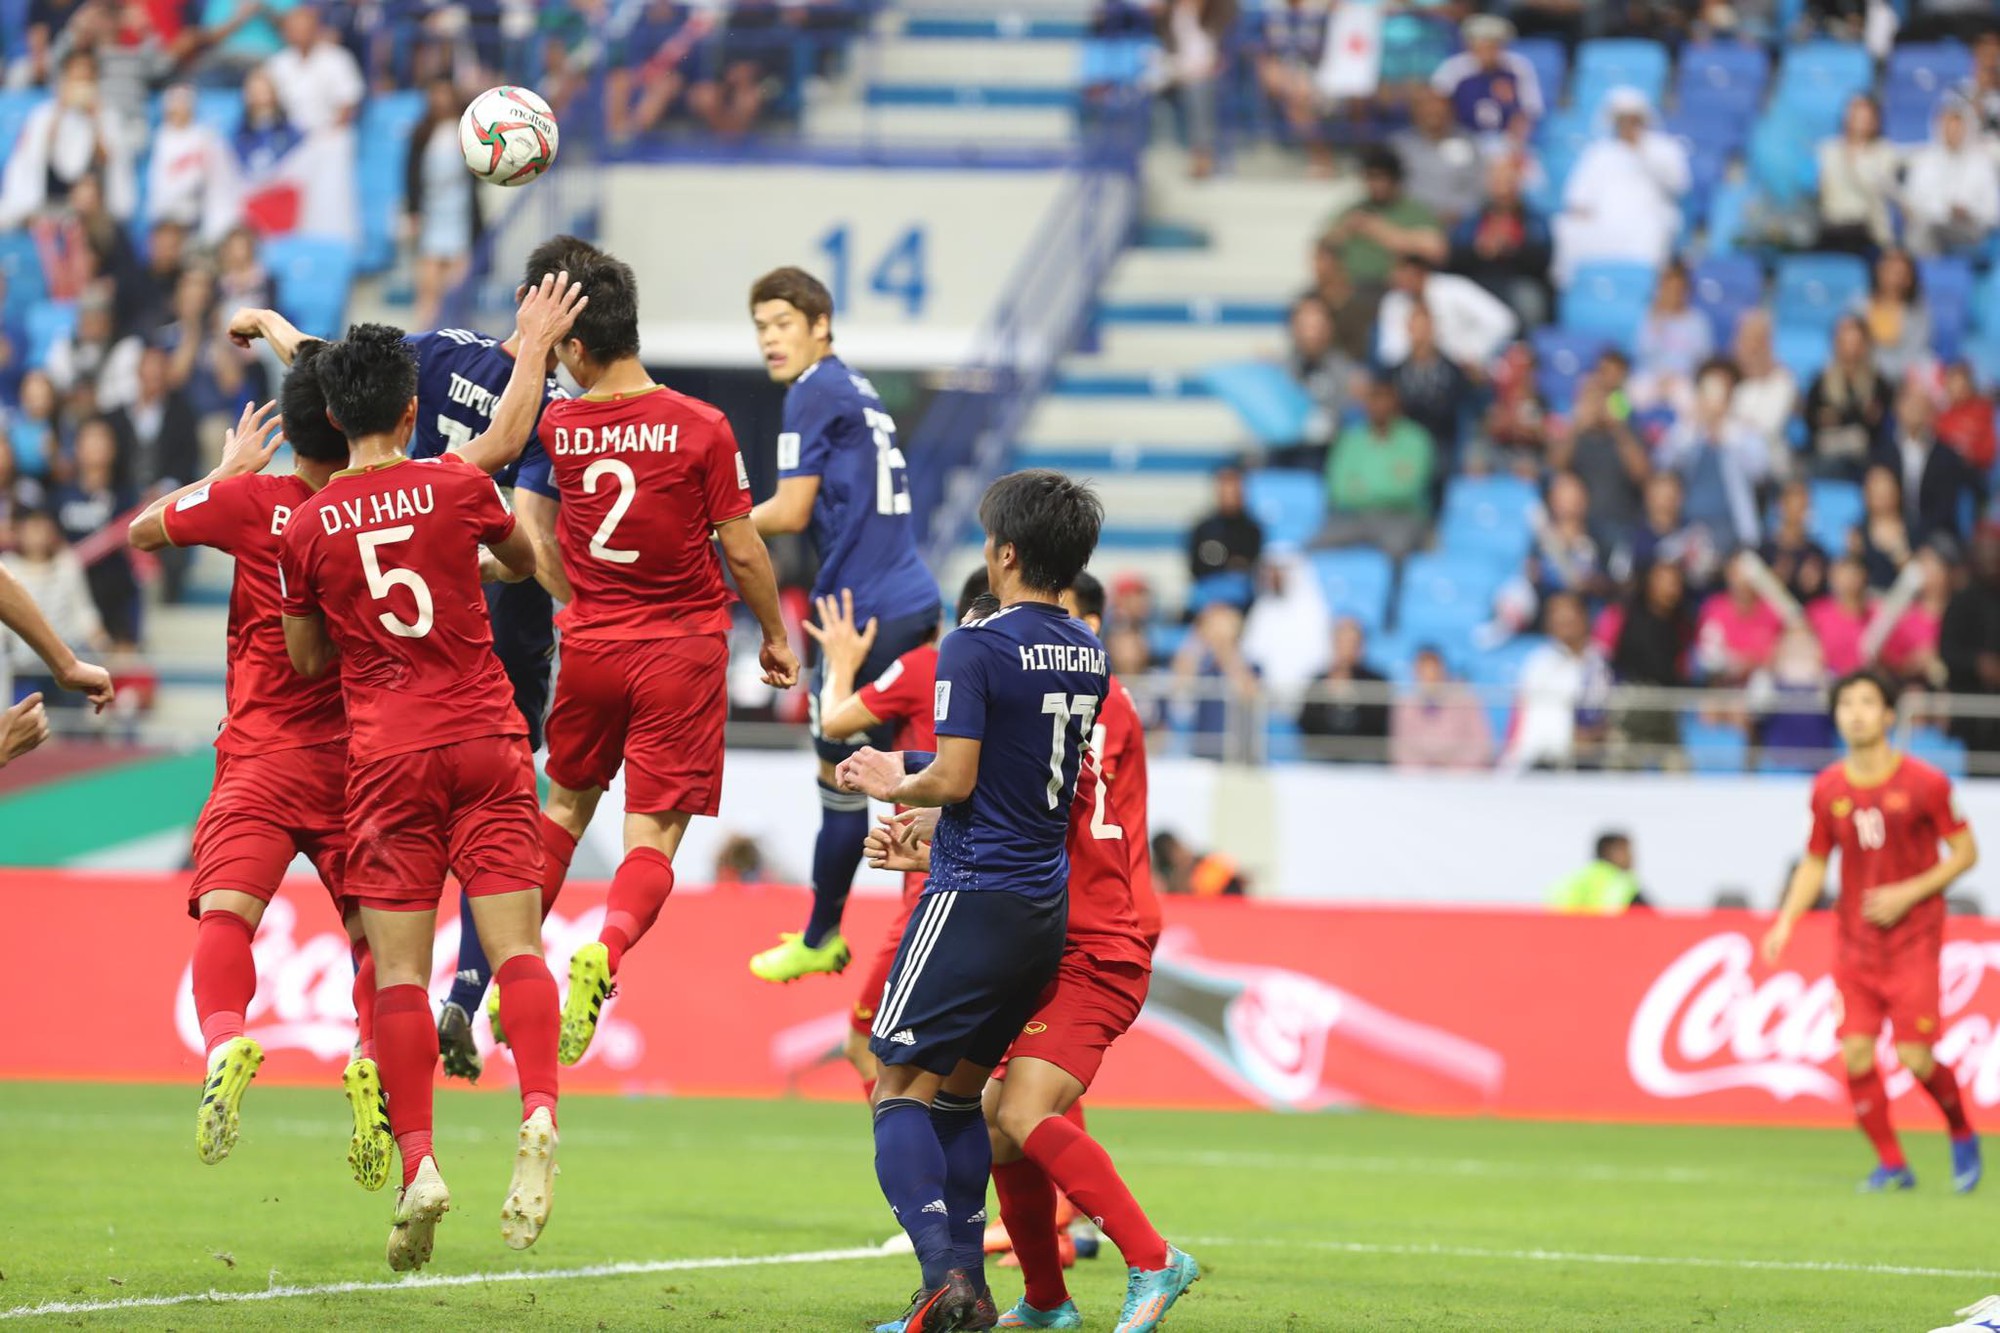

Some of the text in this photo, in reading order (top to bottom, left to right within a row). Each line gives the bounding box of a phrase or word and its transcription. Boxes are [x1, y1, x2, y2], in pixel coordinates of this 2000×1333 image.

[510, 108, 551, 134] molten
[819, 226, 925, 315] 14
[555, 423, 678, 455] D.D.MANH
[319, 484, 434, 535] D.V.HAU
[582, 458, 640, 563] 2
[356, 525, 433, 638] 5
[1019, 644, 1106, 677] KITAGAWA
[1853, 807, 1886, 850] 10
